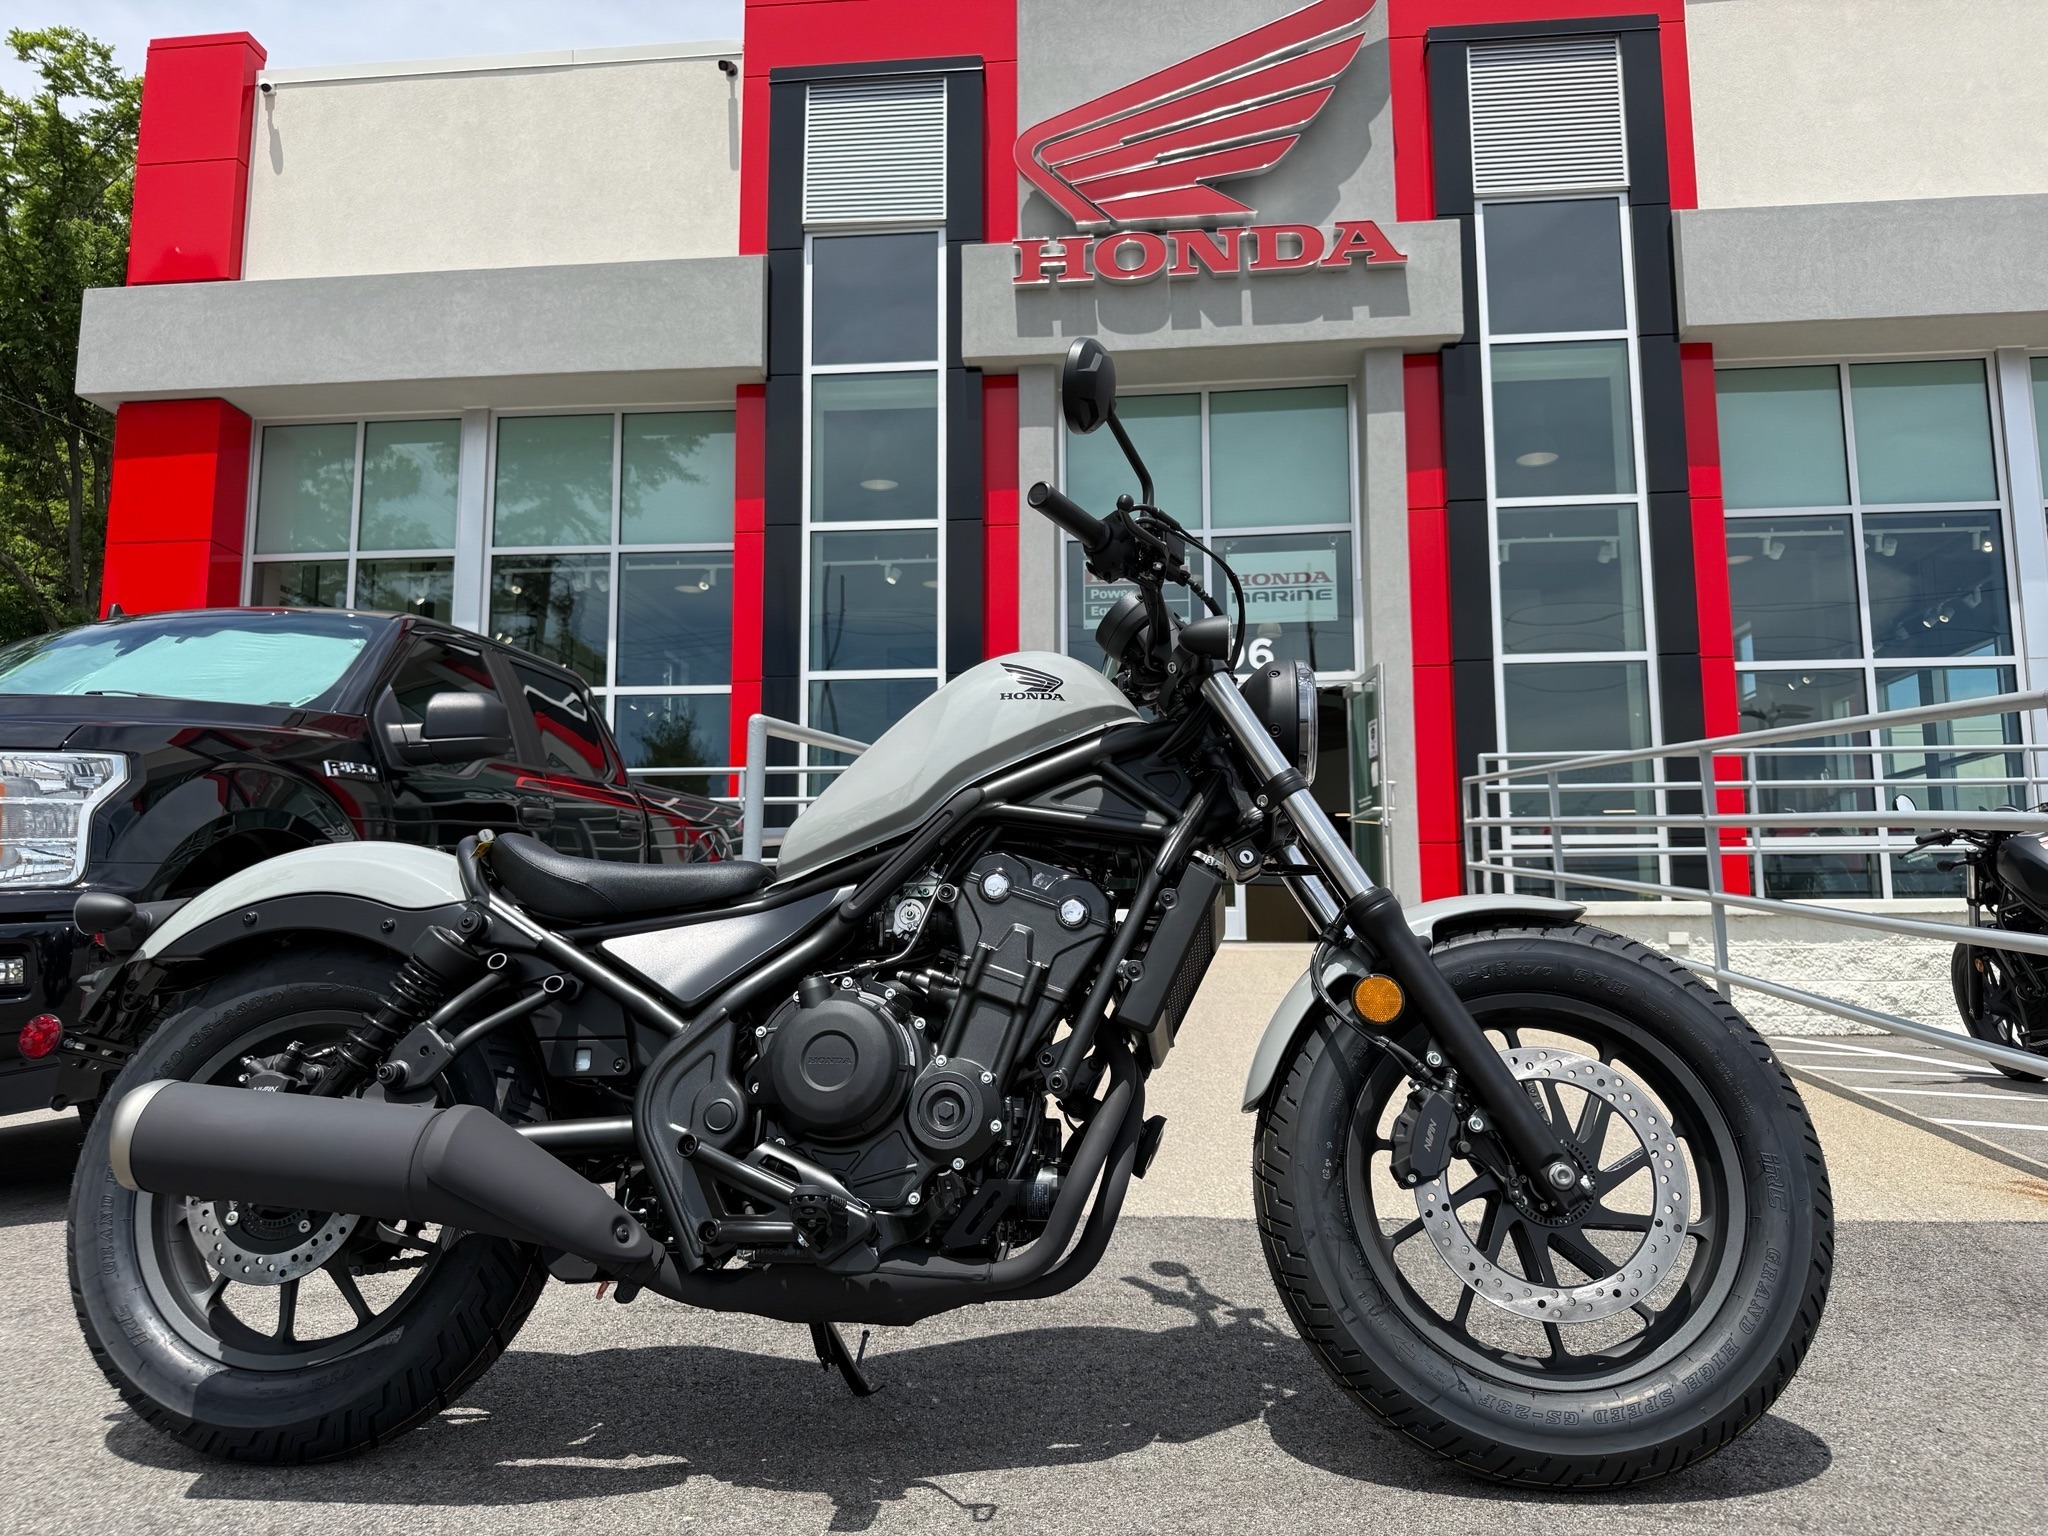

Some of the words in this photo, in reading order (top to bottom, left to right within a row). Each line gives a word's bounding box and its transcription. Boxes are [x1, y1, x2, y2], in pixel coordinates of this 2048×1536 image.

[1012, 220, 1408, 286] HONDA
[1090, 589, 1134, 600] Powe
[1000, 692, 1066, 702] HONDA
[808, 1056, 853, 1065] HONDA
[100, 1194, 117, 1275] GRAND
[1739, 1247, 1781, 1335] GRAND
[1682, 1336, 1741, 1395] HIGH
[1593, 1388, 1676, 1425] SPEED
